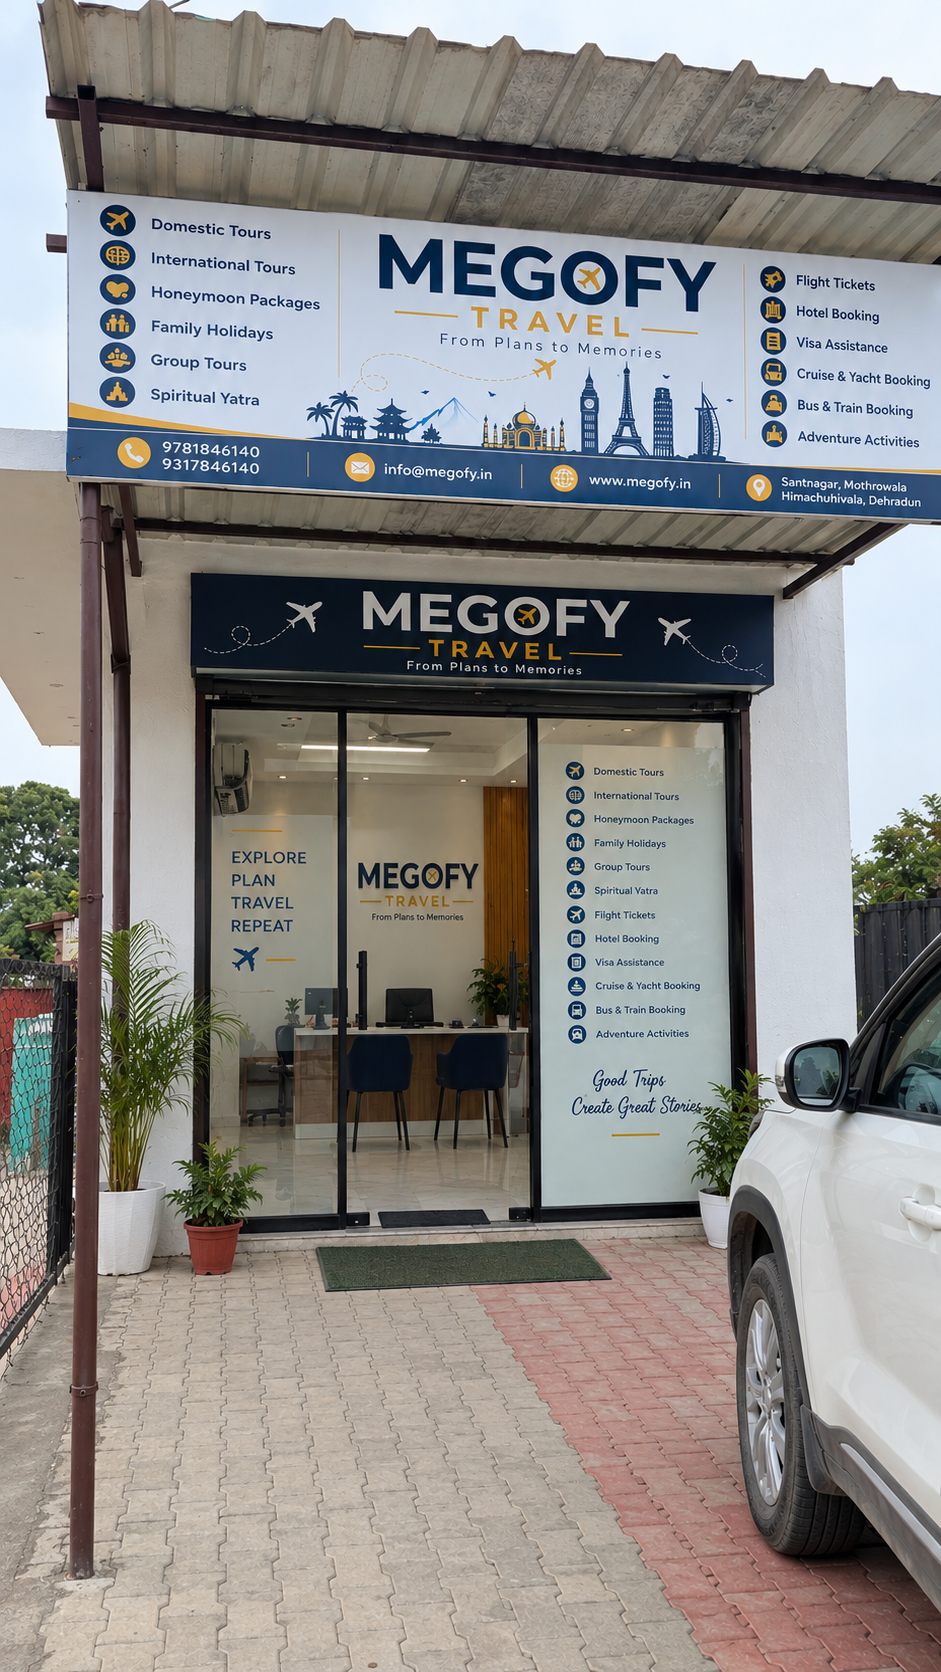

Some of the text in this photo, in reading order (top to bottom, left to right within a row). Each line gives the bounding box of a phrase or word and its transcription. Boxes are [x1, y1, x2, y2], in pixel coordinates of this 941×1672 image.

[152, 218, 271, 239] Domestic Tours
[152, 252, 295, 275] International Tours
[379, 233, 717, 313] MEGOFY
[797, 275, 875, 291] Flight Tickets
[152, 286, 320, 311] Honeymoon Packages
[471, 306, 629, 337] TRAVEL
[797, 306, 879, 324] Hotel Booking
[152, 320, 273, 341] Family Holidays
[441, 333, 661, 359] From Plans to Memories
[797, 337, 888, 353] Visa Assistance
[151, 354, 246, 371] Group Tours
[797, 368, 930, 389] Cruise & Yacht Booking
[151, 389, 259, 405] Spiritual Yatra
[798, 400, 913, 419] Bus & Train Booking
[798, 431, 919, 448] Adventure Activities
[163, 442, 259, 460] 9781846140
[163, 458, 259, 474] 9317846140
[385, 464, 492, 481] info@megofy.in
[589, 477, 690, 491] www.megofy.in
[782, 477, 906, 492] Santnagar, Mothrowala
[869, 496, 921, 507] Dehradun
[362, 590, 631, 639] MEGOFY
[429, 640, 561, 661] TRAVEL
[407, 661, 581, 675] From Plans to Memories
[594, 768, 664, 776] Domestic Tours
[594, 792, 652, 800] International
[594, 815, 694, 826] Honeymoon Packages
[595, 839, 666, 849] Family Holidays
[232, 851, 306, 864] EXPLORE
[594, 863, 650, 872] Group Tours
[232, 874, 274, 886] PLAN
[358, 863, 479, 889] MEGOFY
[595, 887, 632, 896] Spiritual
[231, 897, 293, 909] TRAVEL
[385, 896, 449, 907] TRAVEL
[624, 911, 655, 919] Tickets
[232, 920, 293, 932] REPEAT
[596, 935, 659, 944] Hotel Booking
[595, 958, 614, 966] Visa
[596, 982, 700, 991] Cruise & Yacht Booking
[596, 1006, 685, 1015] Bus & Train Booking
[596, 1030, 644, 1038] Adventure
[593, 1069, 666, 1092] Good Trips
[572, 1096, 703, 1119] Create Great Stories
